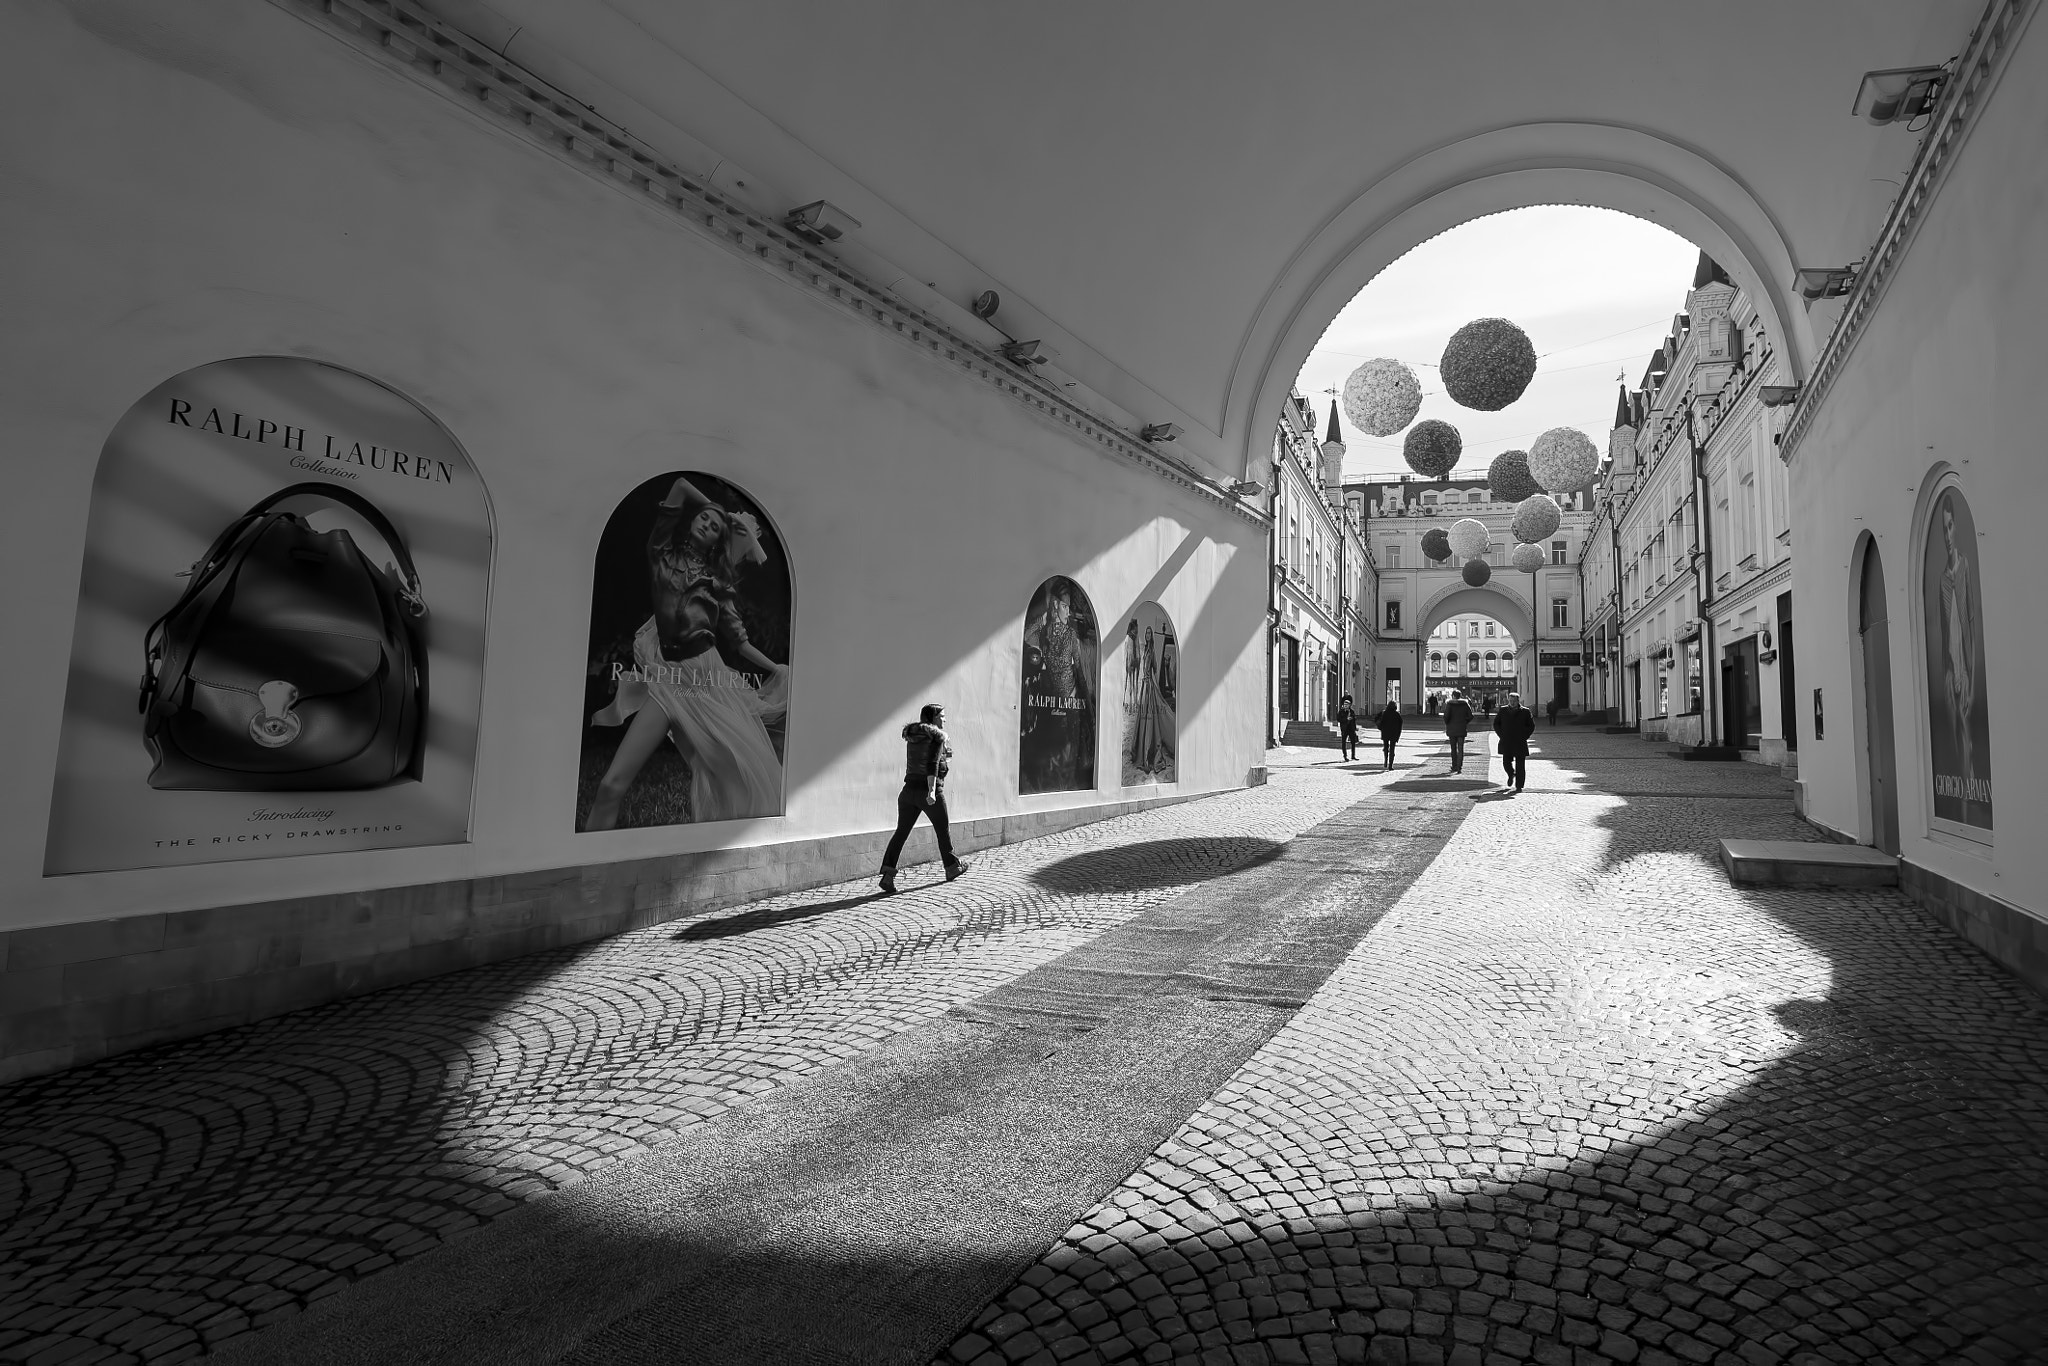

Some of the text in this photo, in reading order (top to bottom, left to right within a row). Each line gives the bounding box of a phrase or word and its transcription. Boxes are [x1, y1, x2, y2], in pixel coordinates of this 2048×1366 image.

[167, 397, 456, 485] RALPH LAUREN
[288, 454, 361, 482] Collection
[610, 662, 764, 690] RALPH LAUREN
[1028, 694, 1086, 710] RALPH LAUREN
[1936, 774, 1963, 798] GIORGIO
[246, 804, 337, 823] Introducing
[154, 823, 404, 849] THE RICKY DRAWSTRING
